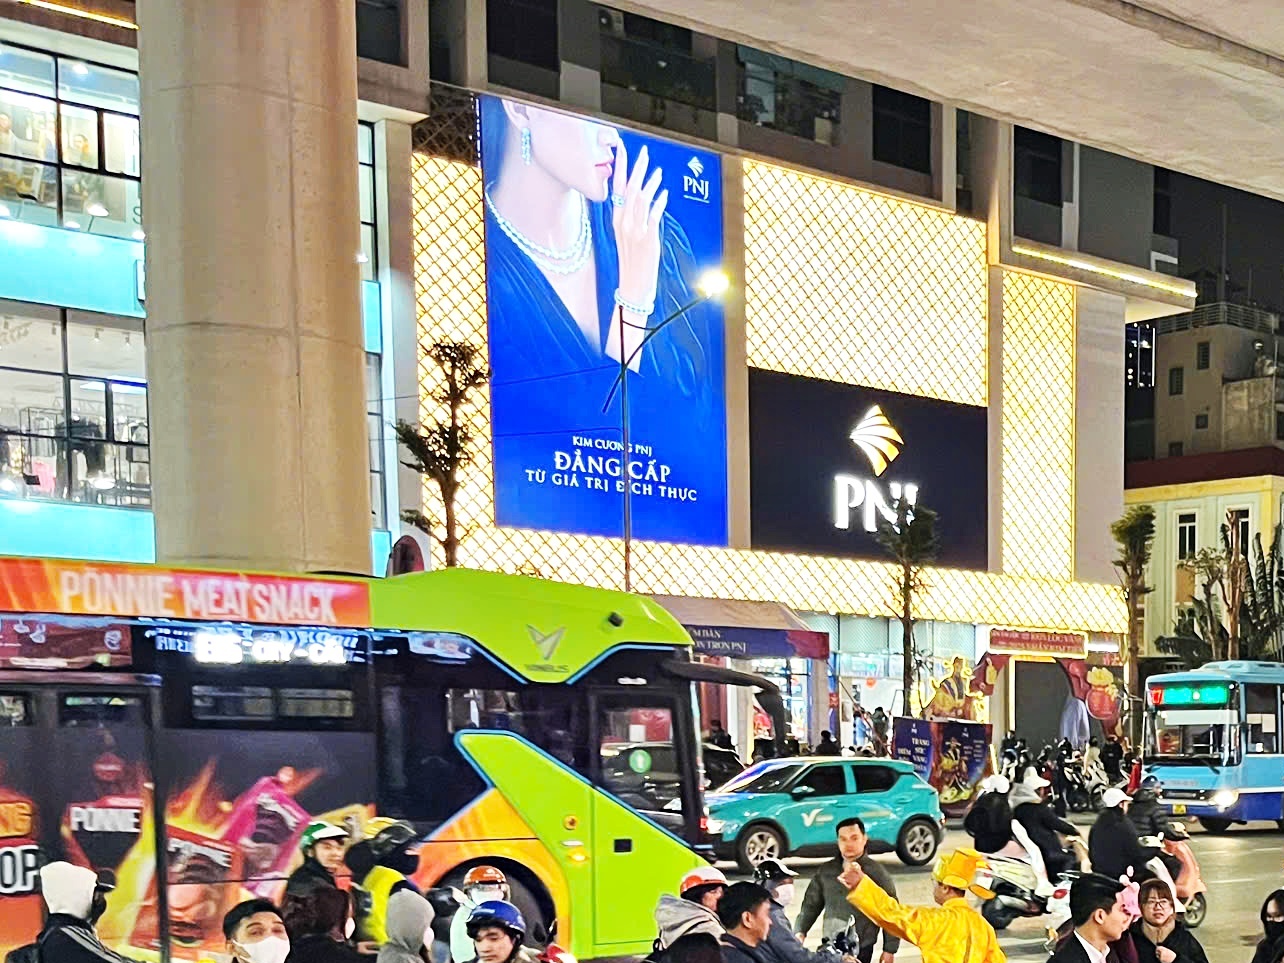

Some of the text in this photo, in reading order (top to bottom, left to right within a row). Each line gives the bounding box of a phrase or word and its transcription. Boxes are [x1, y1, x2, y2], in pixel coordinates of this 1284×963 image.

[683, 175, 709, 200] PNJ
[572, 435, 593, 448] KIM
[635, 444, 653, 457] PNJ
[554, 448, 671, 483] ĐẲNG CẤP
[615, 479, 653, 496] ĐCH
[658, 485, 697, 501] THỰC
[182, 576, 250, 618] MEAT
[252, 582, 337, 624] SNACK
